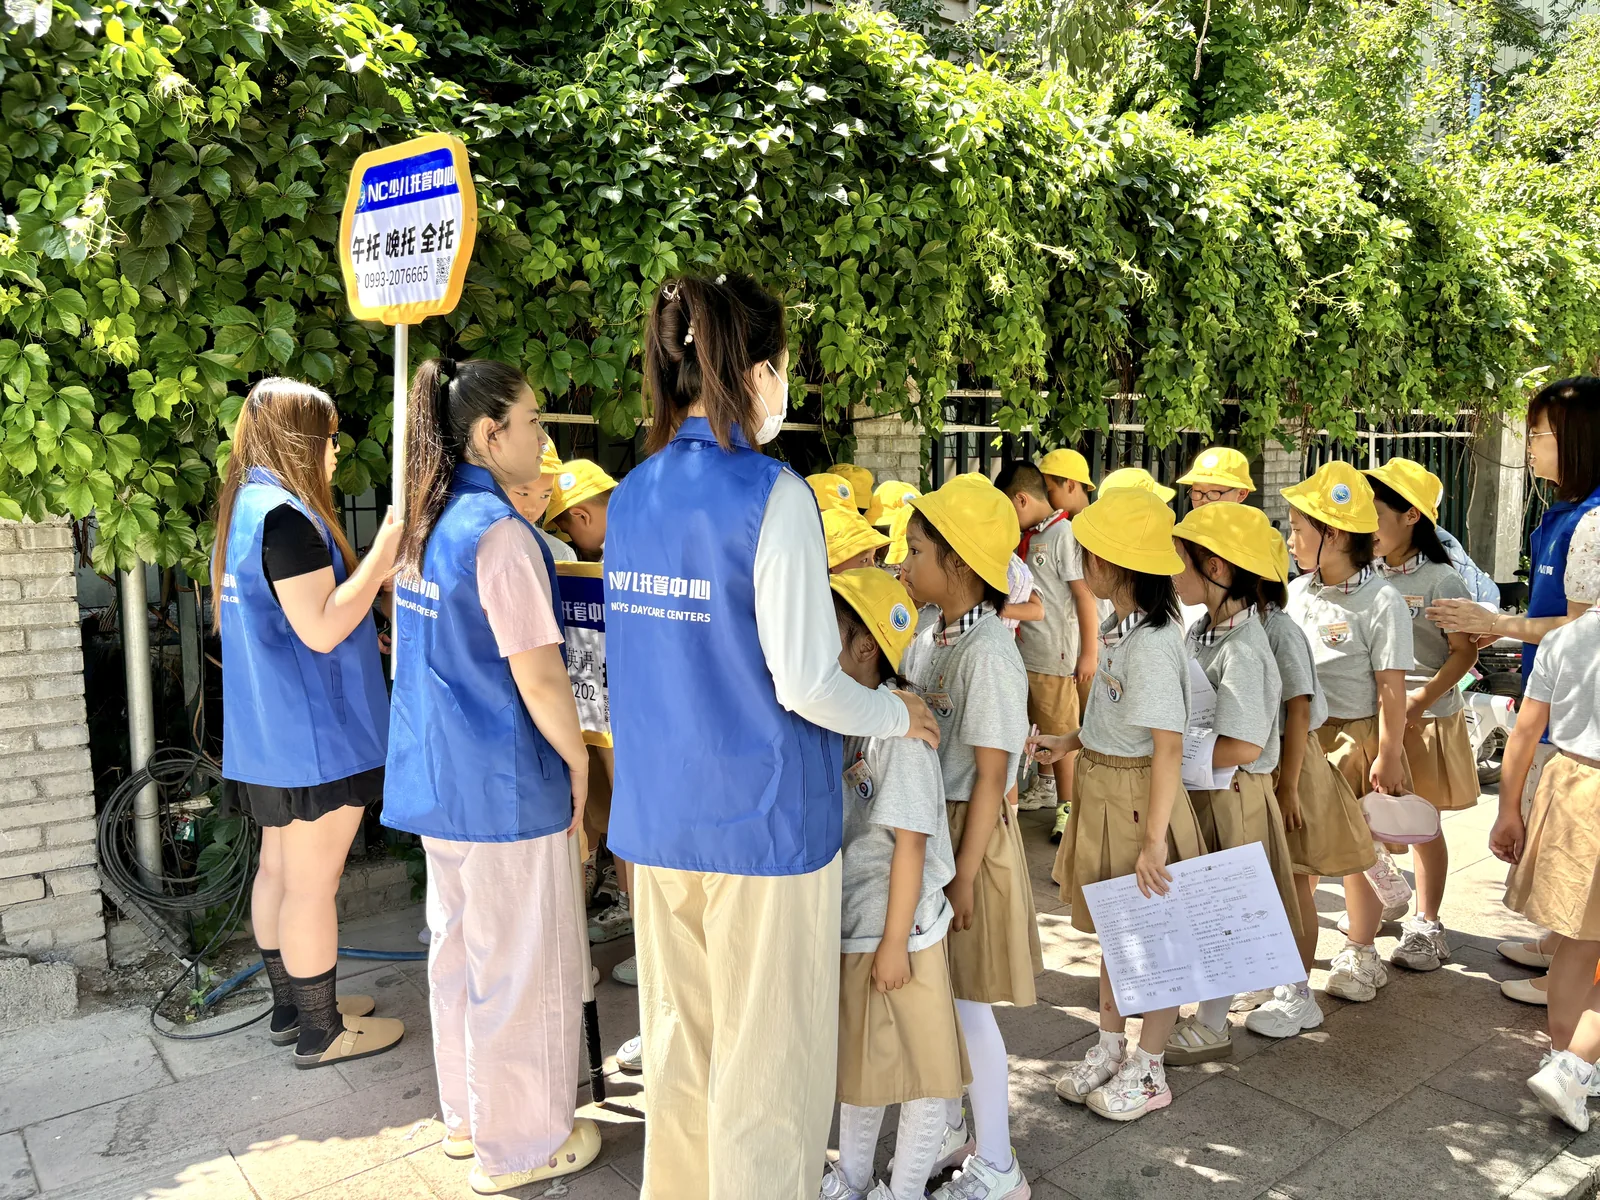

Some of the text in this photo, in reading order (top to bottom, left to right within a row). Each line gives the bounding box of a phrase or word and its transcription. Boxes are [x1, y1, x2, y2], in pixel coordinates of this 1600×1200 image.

[368, 165, 456, 204] NC少儿托管中心
[352, 218, 455, 264] 午托 晚托 全托
[364, 265, 429, 289] 0993-2076665
[562, 601, 606, 623] 托管中
[630, 604, 666, 618] DAYCARE
[667, 609, 711, 623] CENTERS
